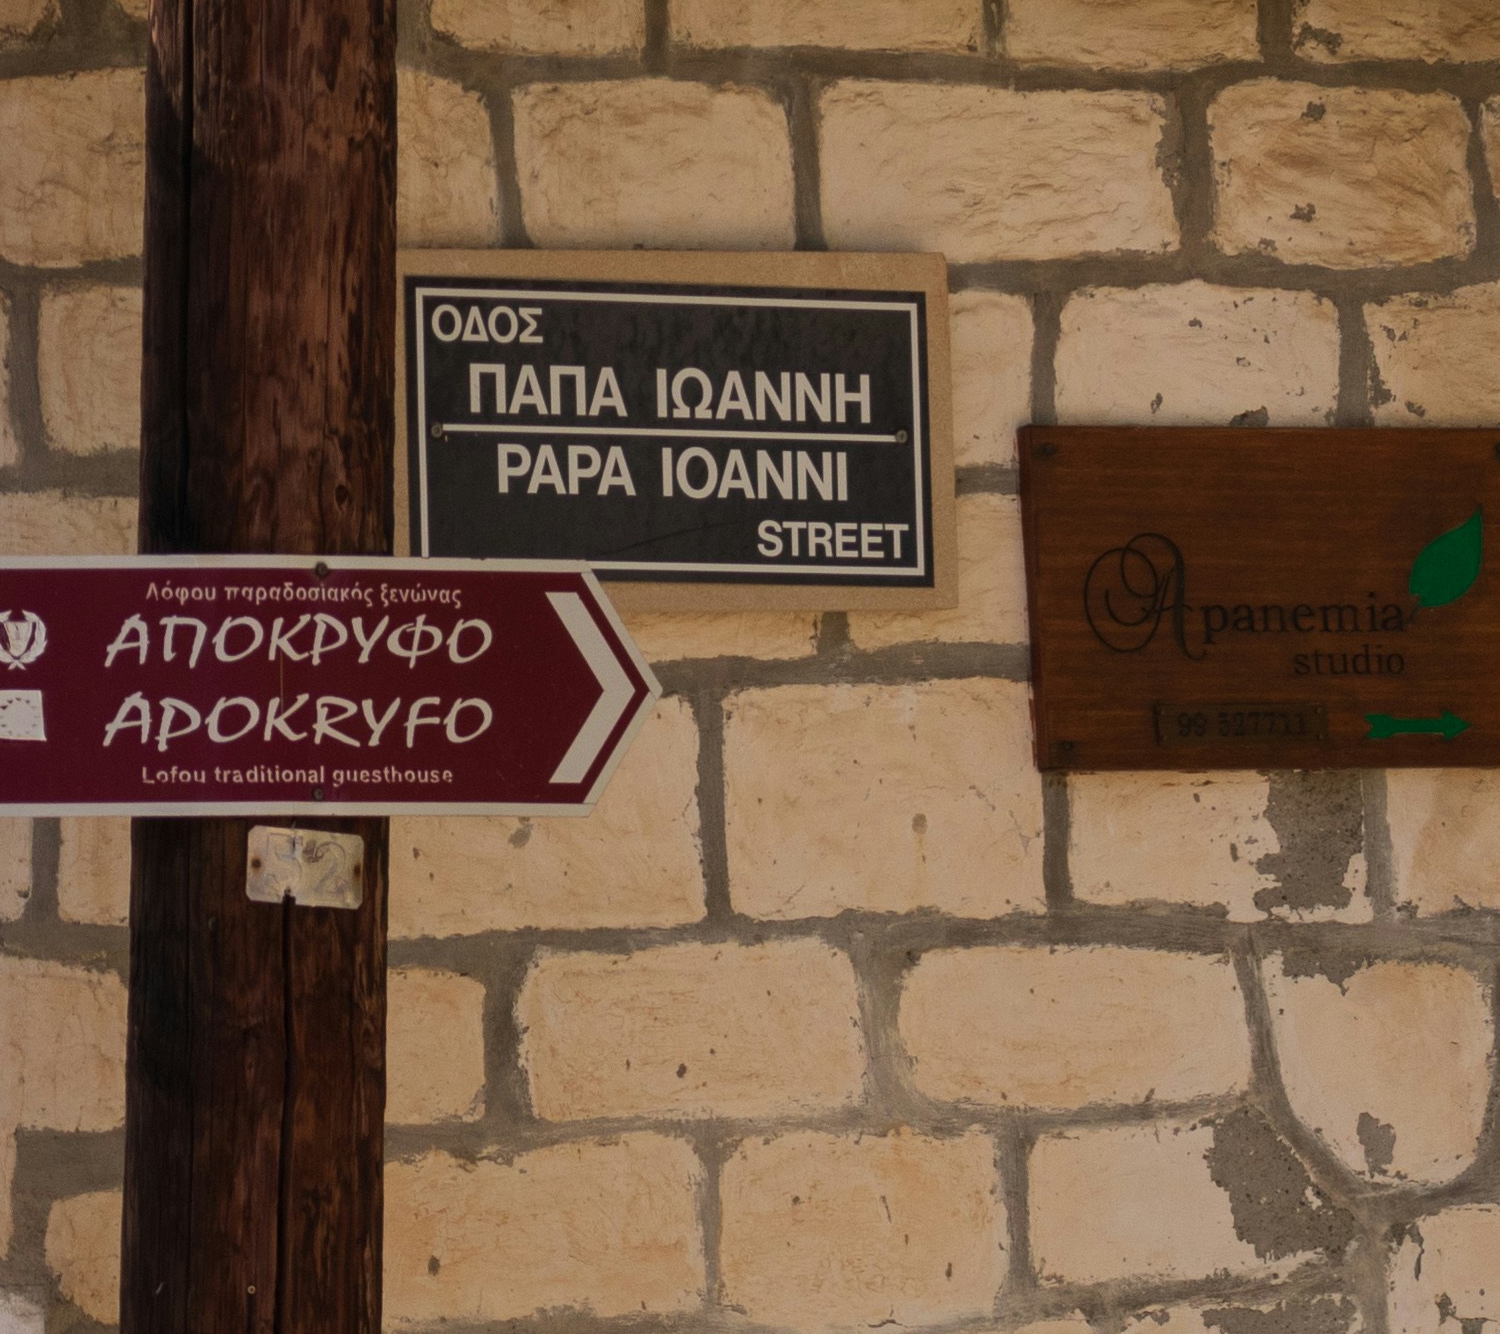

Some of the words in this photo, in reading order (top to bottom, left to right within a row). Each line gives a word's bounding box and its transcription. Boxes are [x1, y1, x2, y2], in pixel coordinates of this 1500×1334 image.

[431, 304, 543, 344] ΟΔΟΣ
[469, 363, 627, 417] ΠΑΠΑ
[655, 367, 871, 424] ΙΩΑΝΝΗ
[497, 443, 636, 496] PAPA
[661, 447, 848, 501] IOANNI
[756, 520, 909, 559] STREET
[146, 580, 216, 605] Λόφου
[224, 581, 374, 607] παραδοσιακός
[380, 582, 462, 609] ξενώνας
[1083, 532, 1408, 661] Apanemia
[105, 612, 492, 669] ΑΠΟΚΡΥΦΟ
[1293, 645, 1405, 676] studio
[103, 692, 492, 752] APOKRYFO
[1177, 711, 1208, 738] 99
[141, 766, 206, 784] Lofou
[214, 765, 325, 784] traditional
[332, 766, 454, 788] guesthouse
